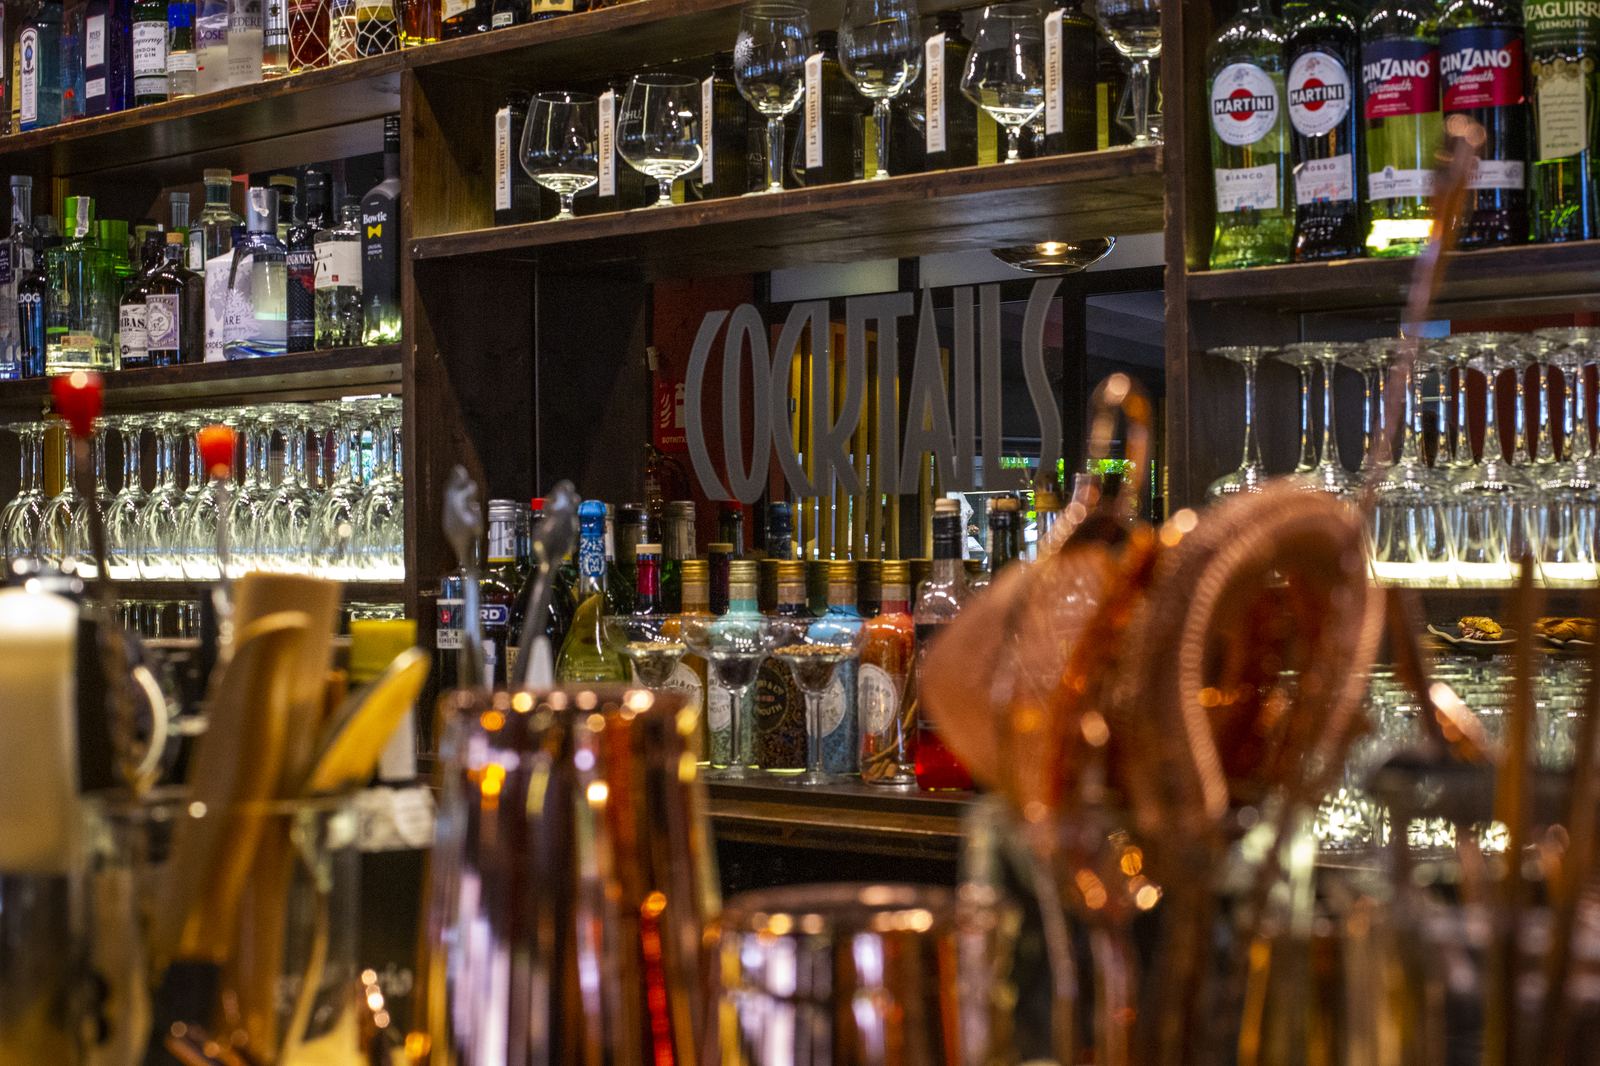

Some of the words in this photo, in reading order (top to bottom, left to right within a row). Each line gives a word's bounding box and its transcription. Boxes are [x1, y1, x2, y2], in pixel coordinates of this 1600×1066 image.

[1535, 19, 1589, 30] VERMOUTH
[1362, 58, 1429, 83] CINZANO
[1440, 48, 1511, 75] CINZANO
[1291, 84, 1343, 104] MARTINI
[1215, 97, 1272, 114] MARTINI
[1225, 172, 1263, 182] BIANCO
[362, 211, 387, 225] Bowtie
[685, 278, 1063, 504] COCKTAILS
